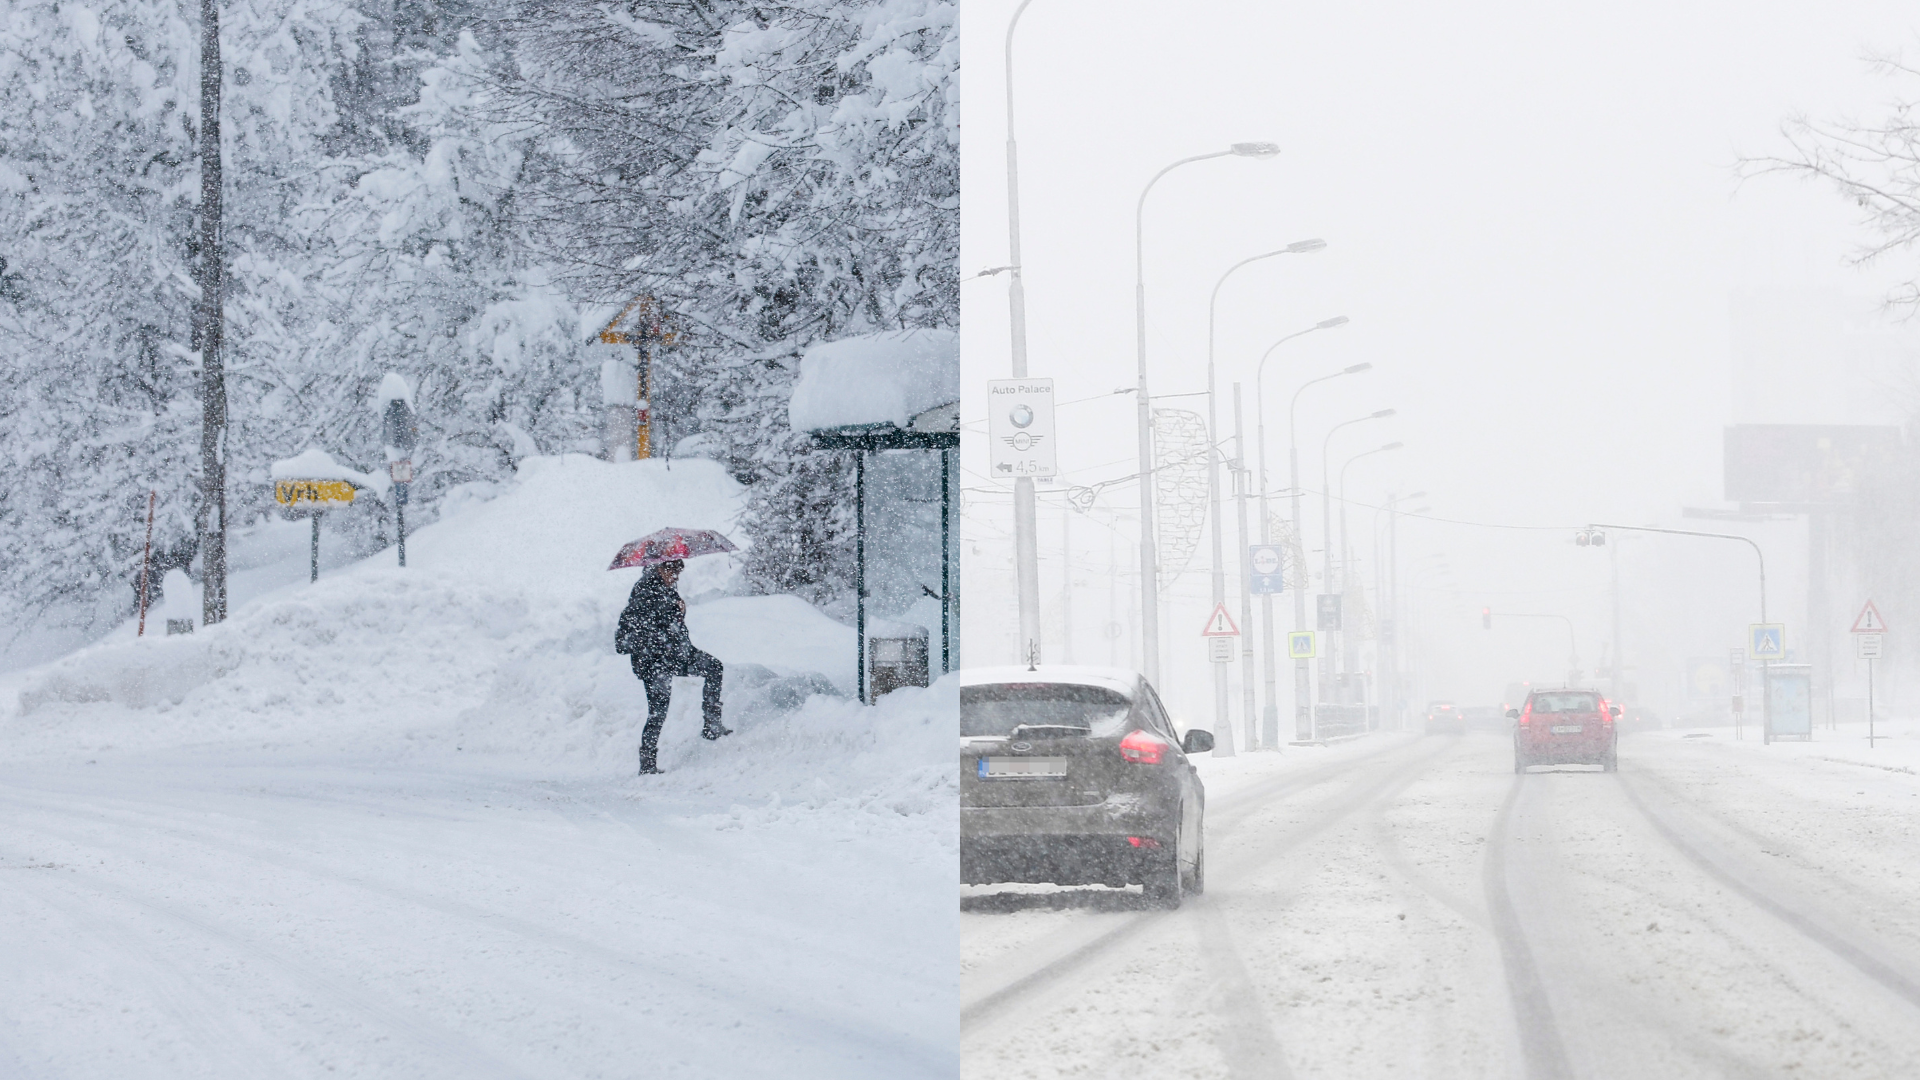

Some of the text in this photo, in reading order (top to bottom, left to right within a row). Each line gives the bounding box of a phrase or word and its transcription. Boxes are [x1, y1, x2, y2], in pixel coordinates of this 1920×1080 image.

[992, 385, 1051, 394] Auto Palace
[1016, 460, 1037, 475] 4,5
